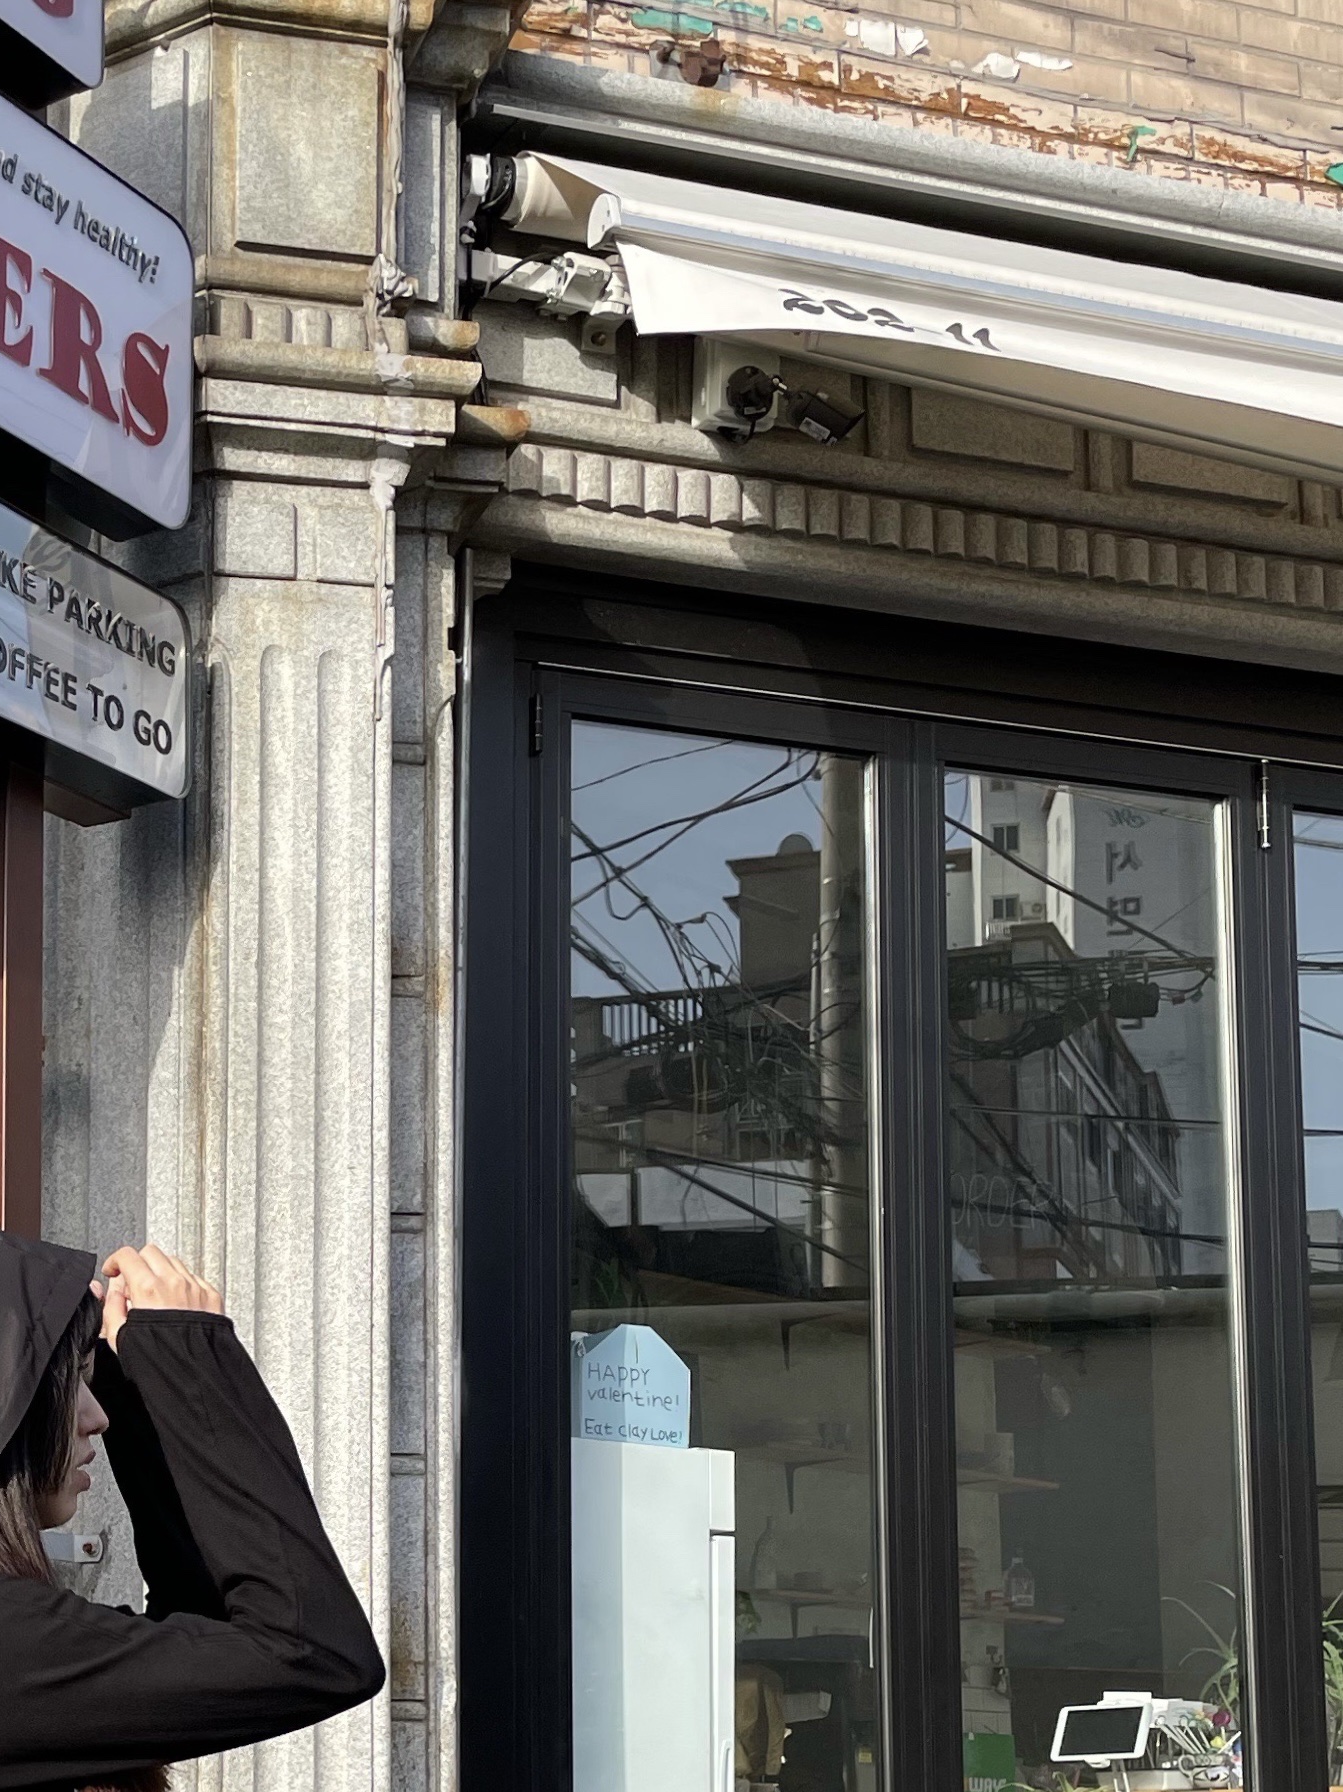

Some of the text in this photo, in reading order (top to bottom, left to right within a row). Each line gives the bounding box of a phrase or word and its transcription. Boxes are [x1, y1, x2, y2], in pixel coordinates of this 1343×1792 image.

[22, 171, 70, 225] stay
[73, 200, 160, 284] healthy!
[47, 577, 176, 677] PARKING
[86, 683, 124, 731] TO
[134, 709, 173, 755] GO
[584, 1417, 613, 1436] Eat
